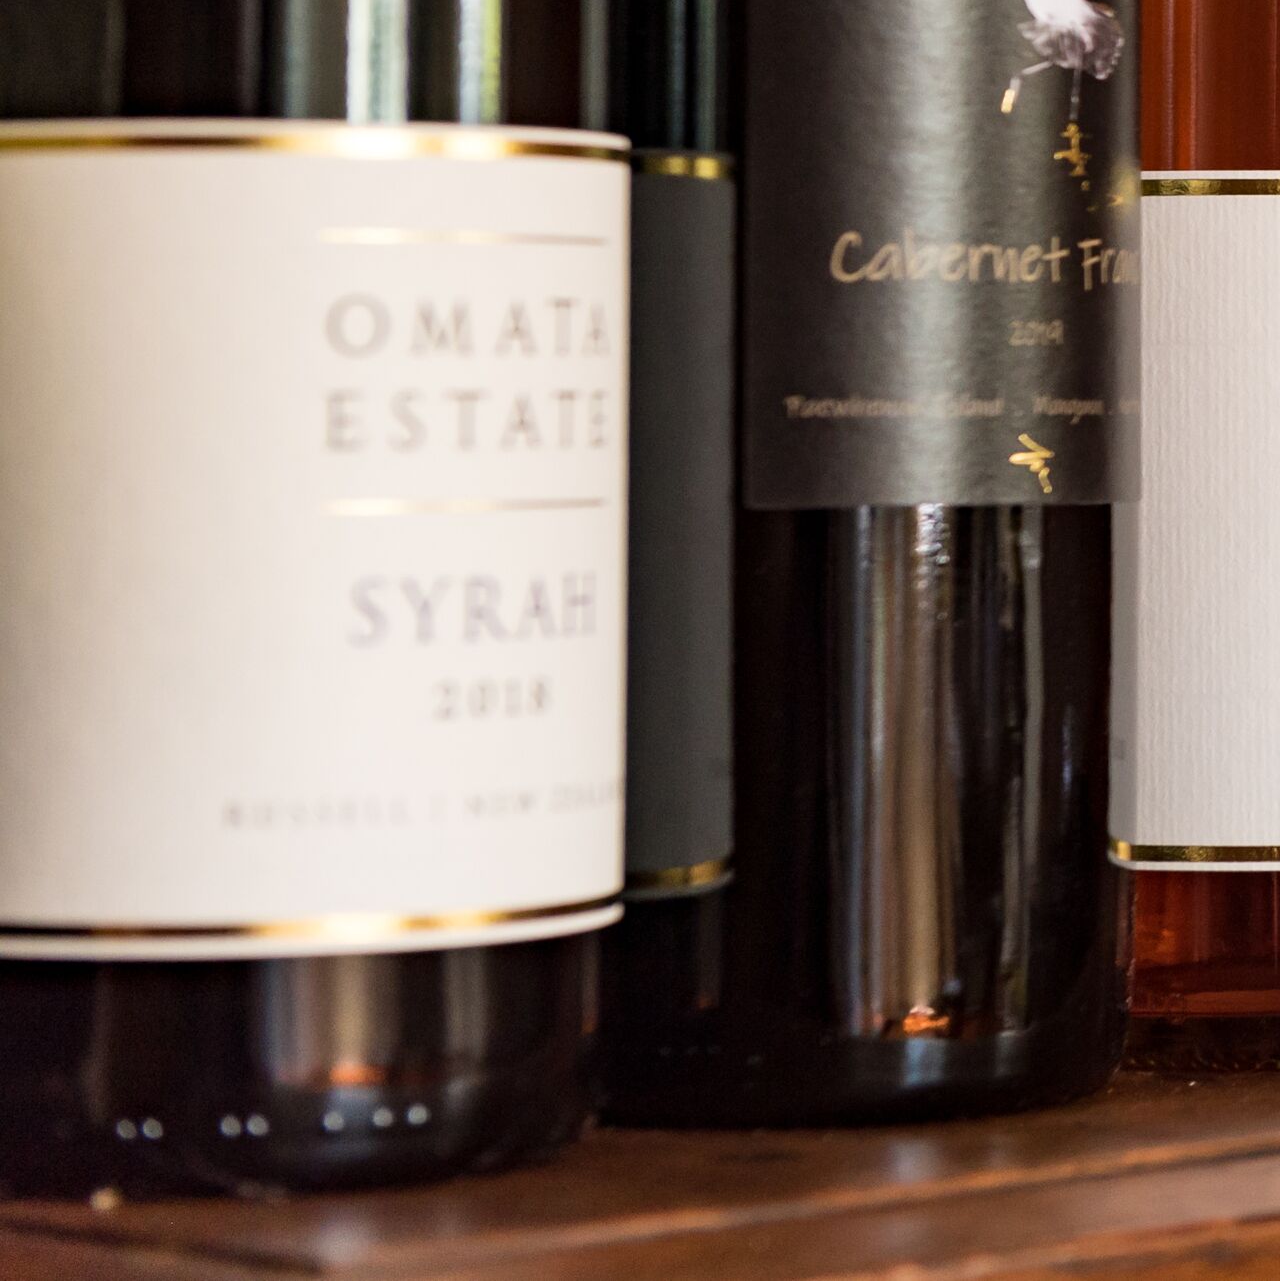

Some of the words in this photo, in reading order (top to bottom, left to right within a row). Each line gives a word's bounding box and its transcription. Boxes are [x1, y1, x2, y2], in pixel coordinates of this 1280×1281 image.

[829, 230, 1071, 284] Cabernet
[325, 292, 611, 360] OMATA
[323, 389, 608, 454] ESTATE
[346, 571, 598, 648] SYRAH
